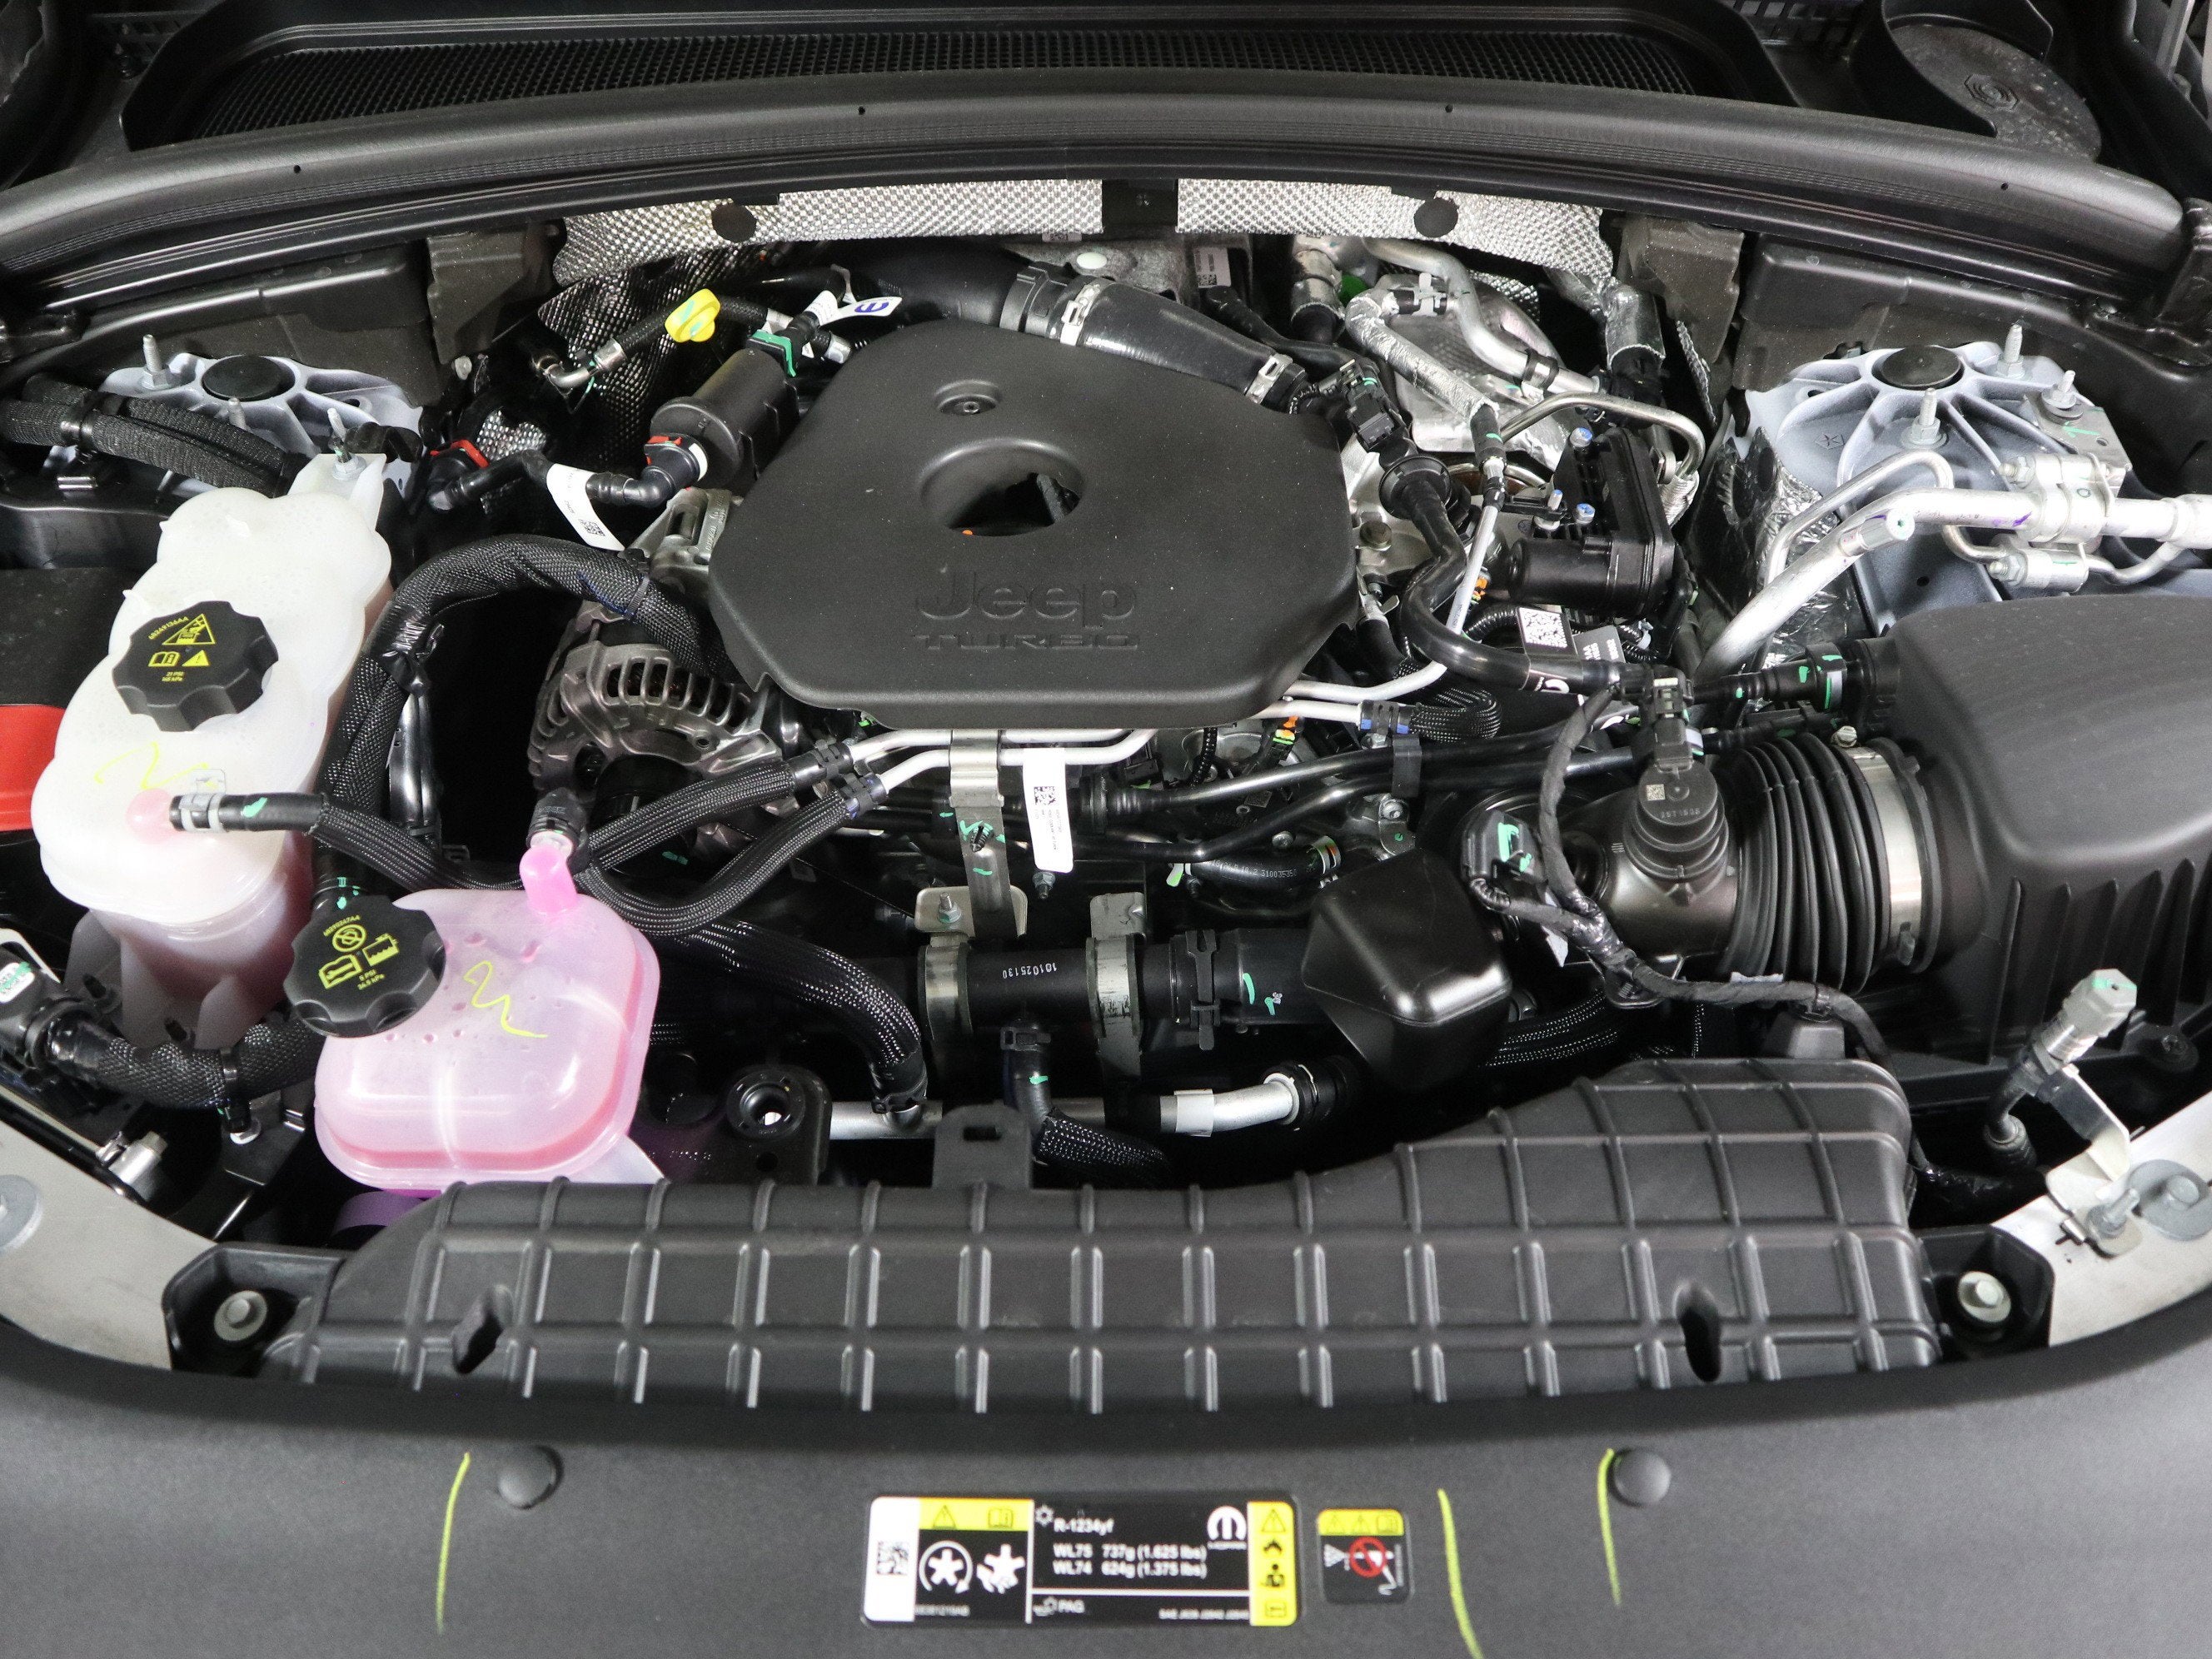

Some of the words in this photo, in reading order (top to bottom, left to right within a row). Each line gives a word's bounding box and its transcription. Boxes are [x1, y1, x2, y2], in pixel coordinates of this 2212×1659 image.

[917, 570, 1138, 631] Jeep
[914, 633, 1138, 650] TURBO
[1054, 1517, 1114, 1536] R-1234yf
[1053, 1543, 1093, 1558] WL75
[1053, 1560, 1093, 1575] WL74
